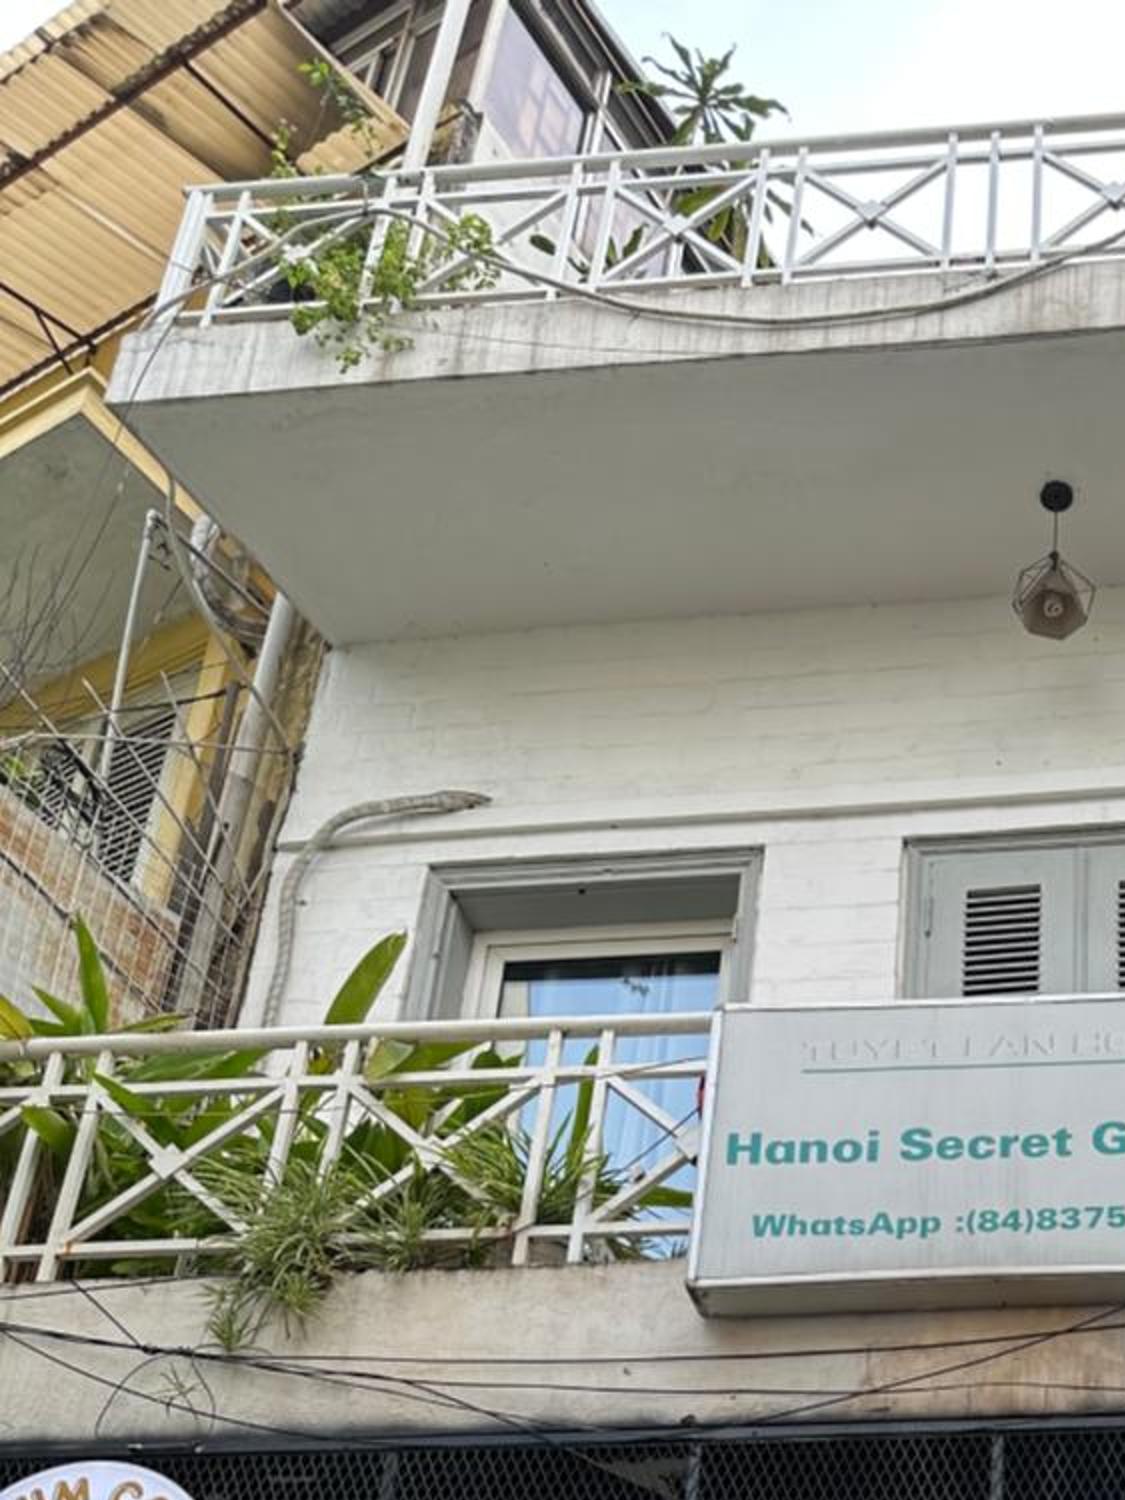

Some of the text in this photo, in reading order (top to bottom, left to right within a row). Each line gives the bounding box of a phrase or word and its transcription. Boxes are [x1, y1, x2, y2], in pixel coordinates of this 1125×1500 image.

[725, 1130, 879, 1165] Hanoi
[900, 1126, 1072, 1162] Secret
[753, 1211, 941, 1239] WhatsApp
